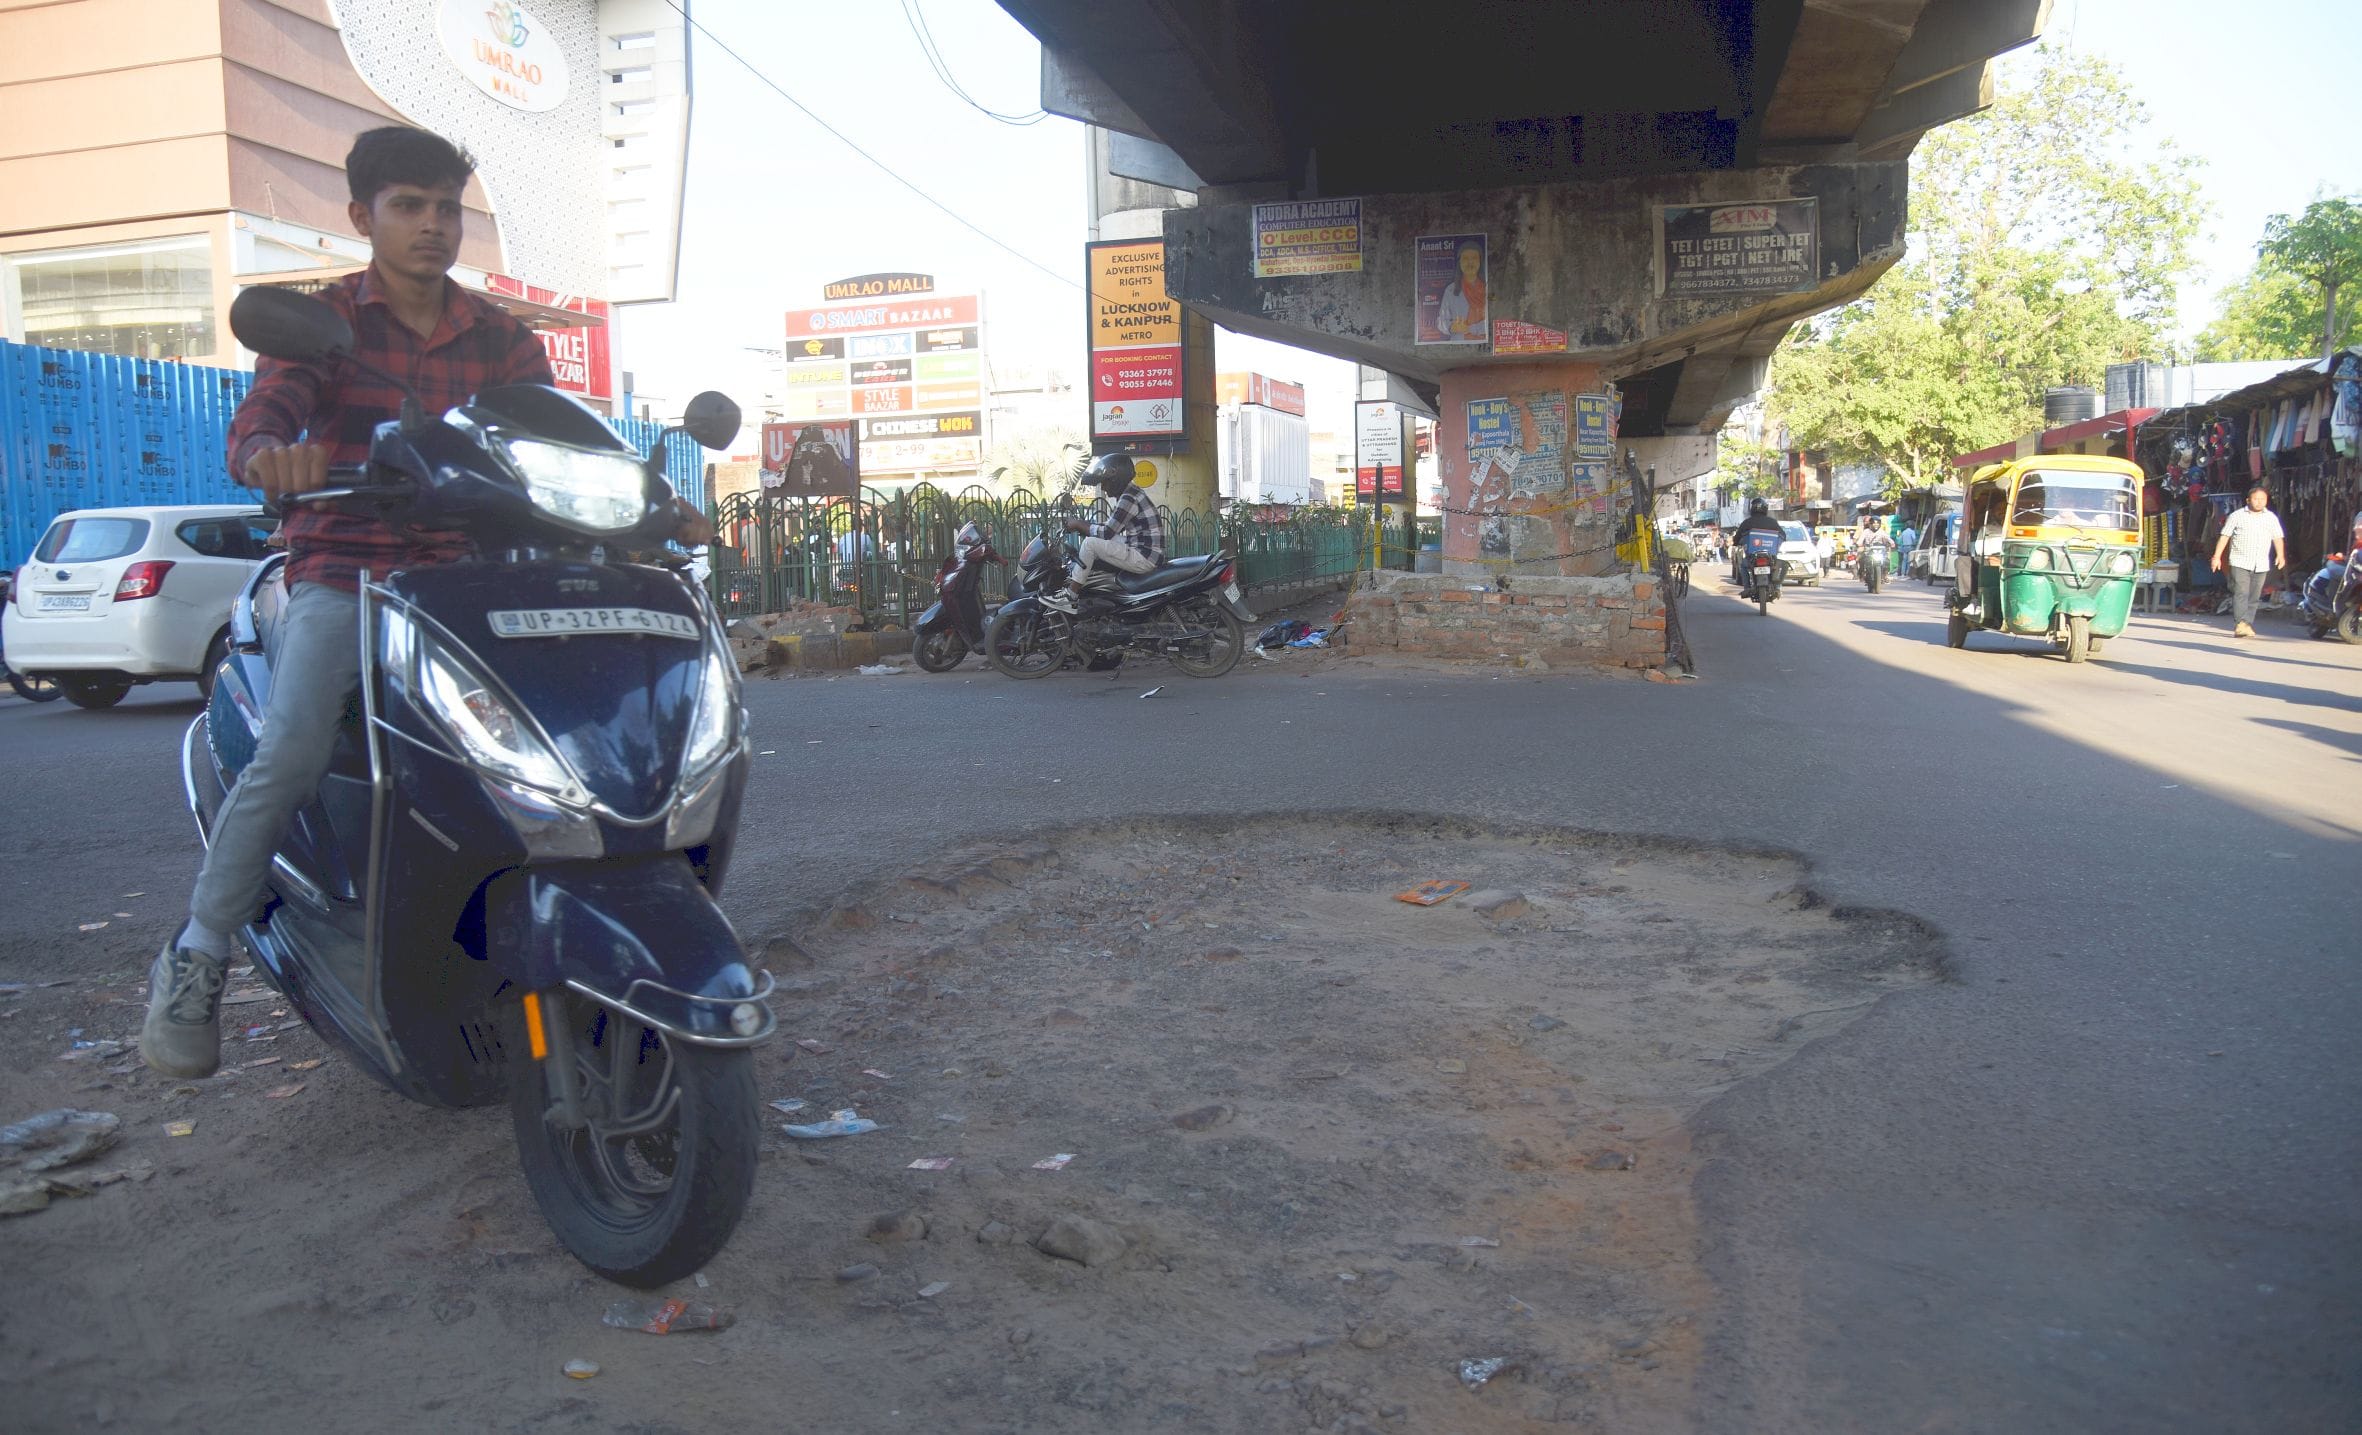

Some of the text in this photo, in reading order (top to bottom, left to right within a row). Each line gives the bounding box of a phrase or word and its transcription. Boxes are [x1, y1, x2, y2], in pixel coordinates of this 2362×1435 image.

[473, 39, 541, 85] UMRAO
[493, 76, 528, 102] MALL
[1260, 200, 1358, 221] RUDRA ACADEMY
[1718, 208, 1769, 223] AIM
[1260, 217, 1358, 232] COMPUTER EDUCATION
[1339, 242, 1357, 252] TALLY
[1671, 232, 1810, 253] TET CTET SUPER TET
[1112, 253, 1160, 263] EXCLUSIVE
[1678, 249, 1803, 268] TGT PGT NET JRF
[825, 276, 931, 299] UMRAO MALL
[1120, 277, 1152, 286] RIGHTS
[1101, 302, 1170, 315] LUCKNOW
[827, 307, 953, 329] SMART BAZAAR
[1101, 315, 1172, 328] & KANPUR
[1121, 331, 1152, 340] METRO
[532, 330, 584, 362] TYLE
[1119, 368, 1173, 378] 93362 37978
[38, 379, 81, 390] JUMBO
[1119, 379, 1173, 388] 93055 67446
[133, 390, 171, 401] JUMBO
[864, 389, 899, 403] STYLE
[864, 401, 900, 412] BAAZAR
[872, 416, 973, 436] CHINESE WOK
[1479, 417, 1500, 429] Hostel
[44, 460, 86, 471] JUMBO
[138, 465, 176, 476] JUMBO
[523, 612, 551, 629] UP
[566, 611, 624, 628] 32PF
